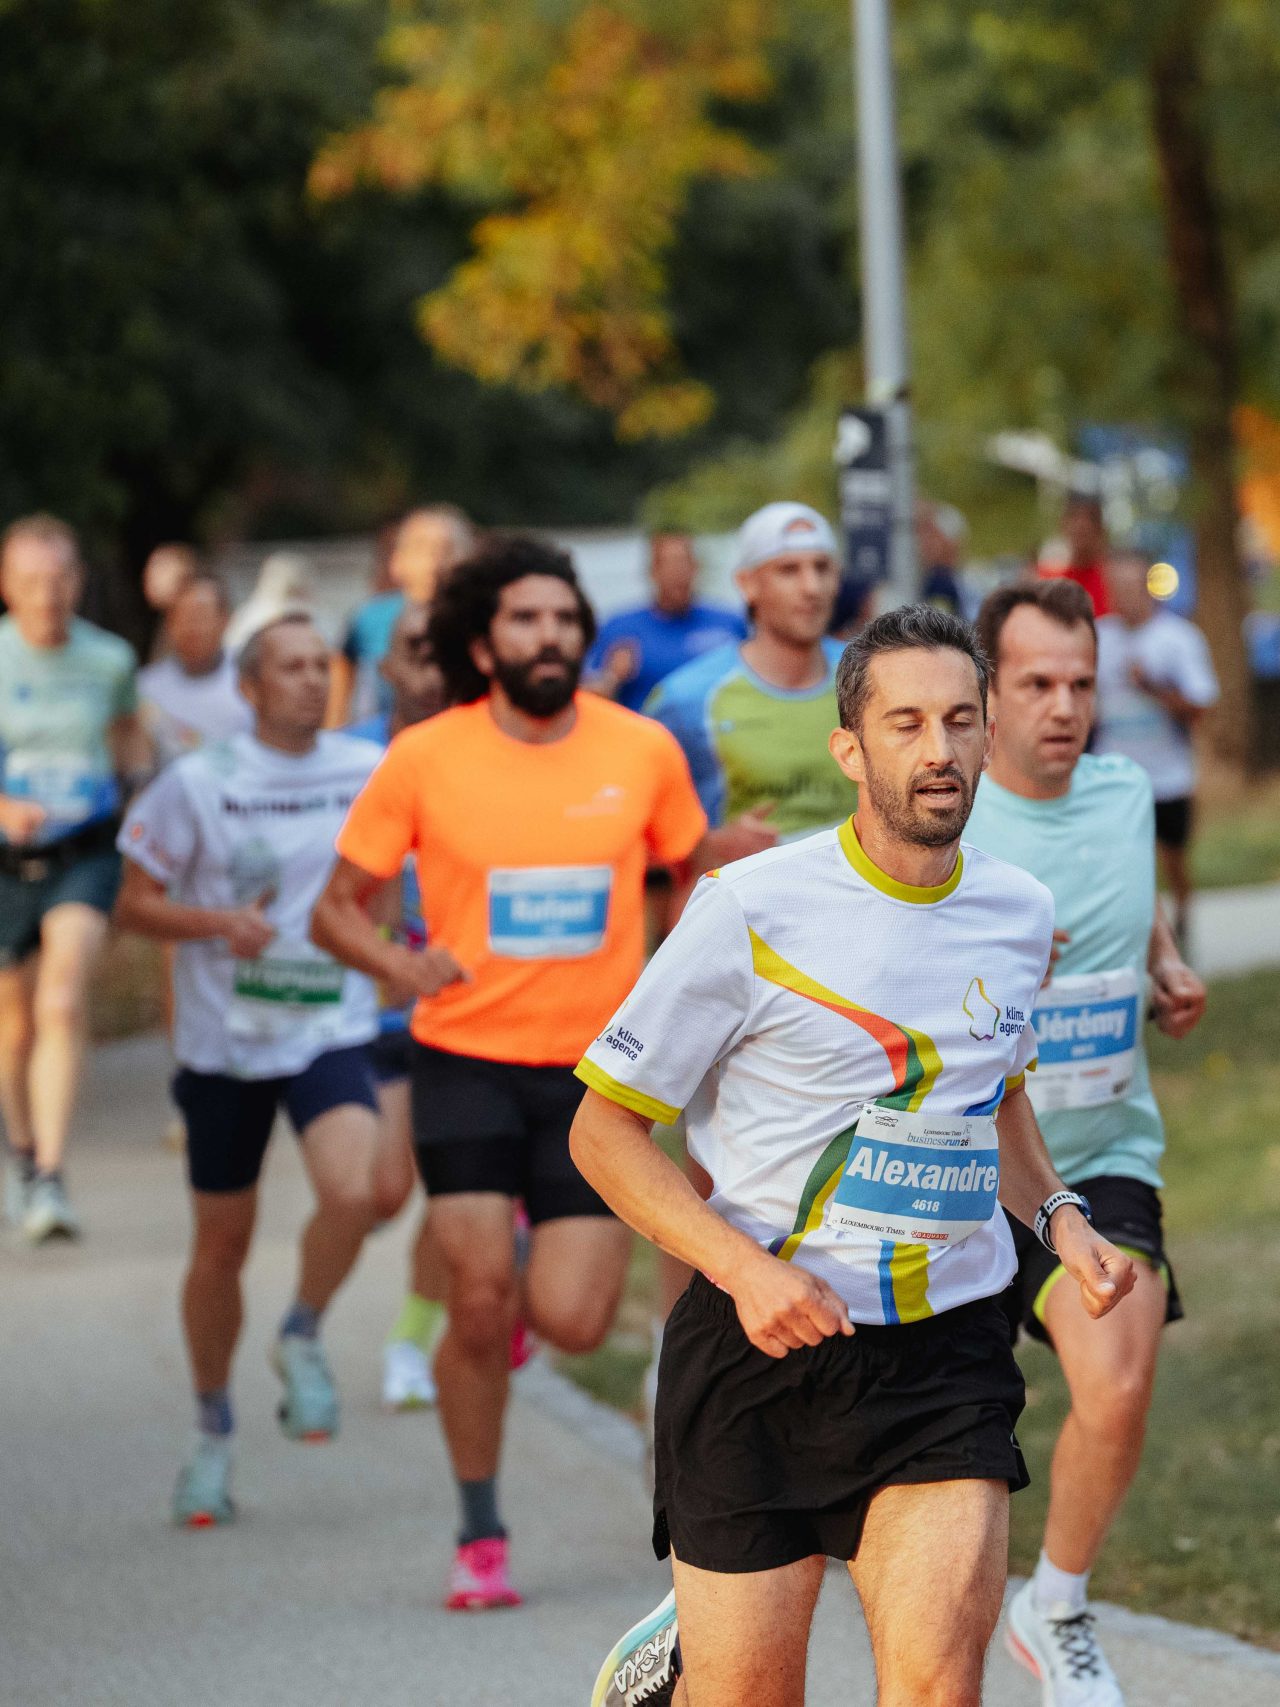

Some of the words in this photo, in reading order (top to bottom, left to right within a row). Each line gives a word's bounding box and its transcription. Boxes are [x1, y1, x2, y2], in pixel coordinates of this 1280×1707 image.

[606, 1034, 638, 1061] agence
[617, 1026, 644, 1052] klima
[846, 1146, 997, 1192] Alexandre
[912, 1199, 940, 1213] 4618
[614, 1627, 672, 1695] HOKA
